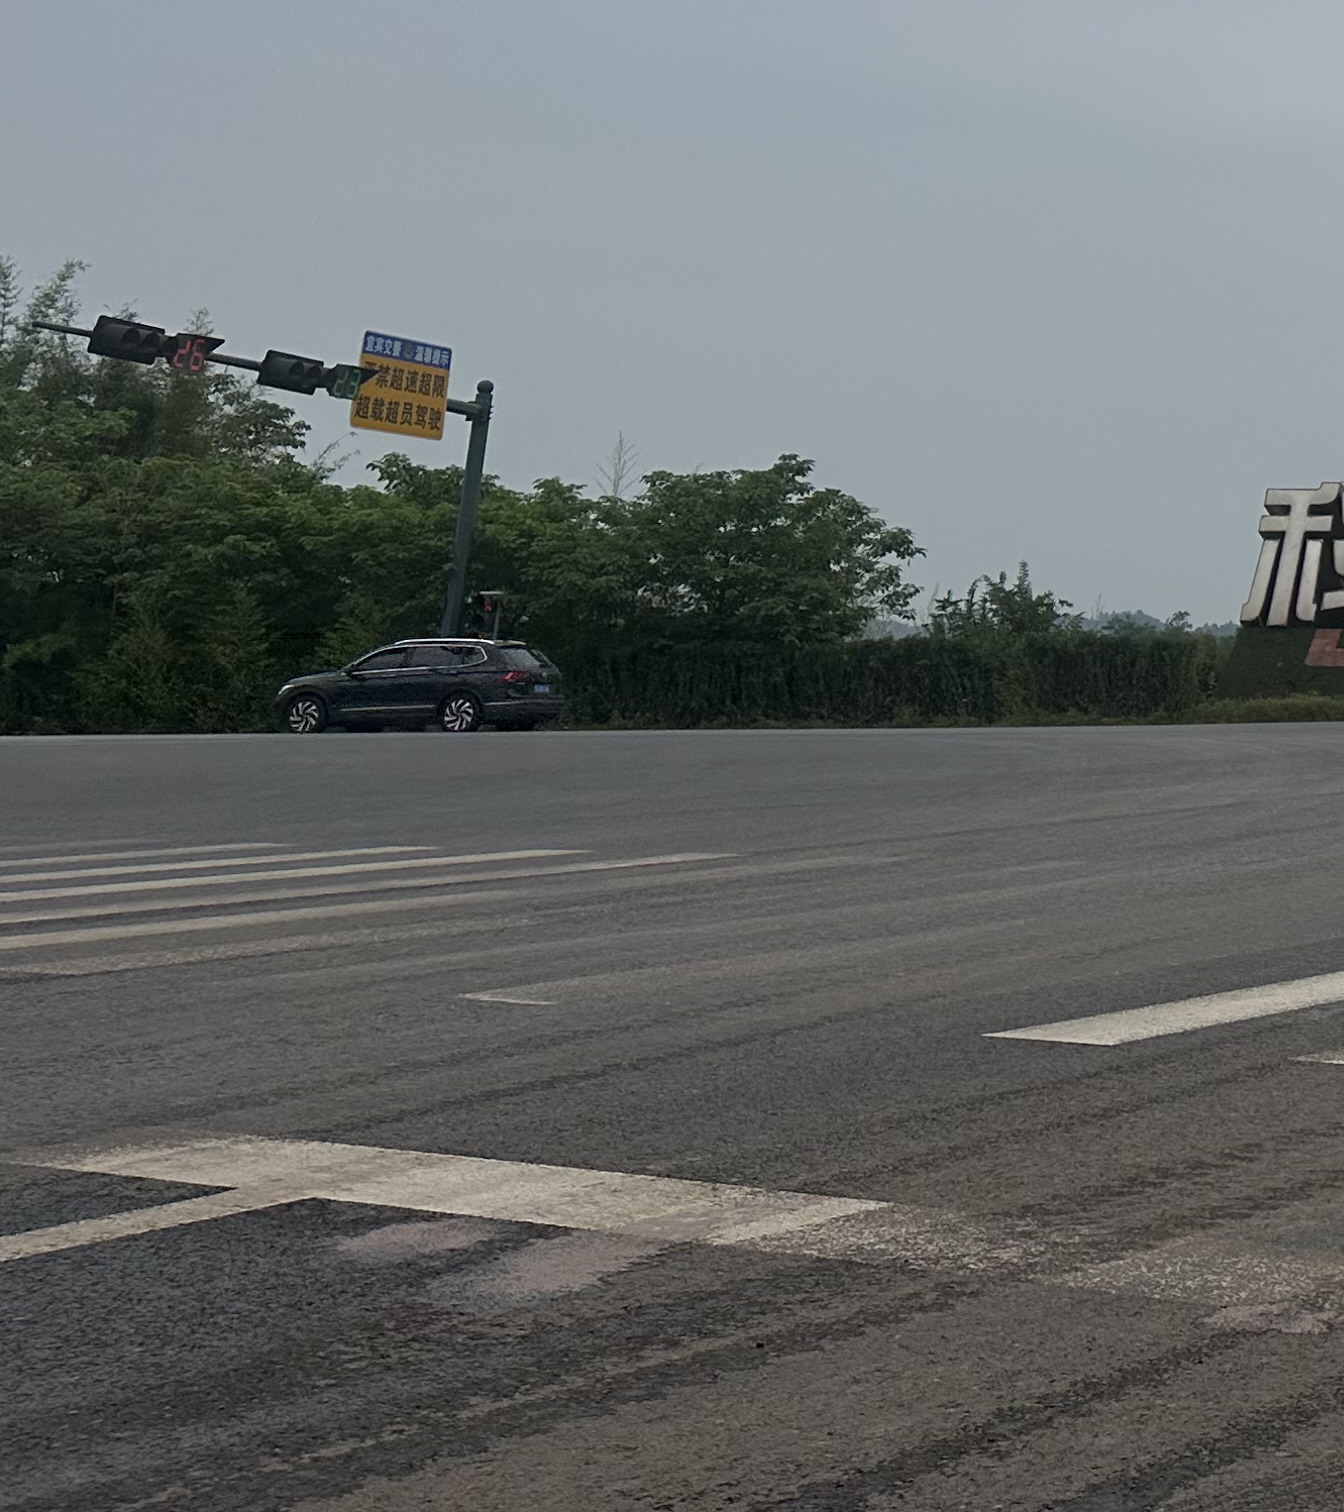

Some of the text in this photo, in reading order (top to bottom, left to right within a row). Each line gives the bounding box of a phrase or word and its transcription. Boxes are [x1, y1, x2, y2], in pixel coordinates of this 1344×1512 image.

[173, 338, 205, 371] 26
[365, 335, 402, 357] 宜宾交警
[354, 394, 442, 431] 超载超员驾驶
